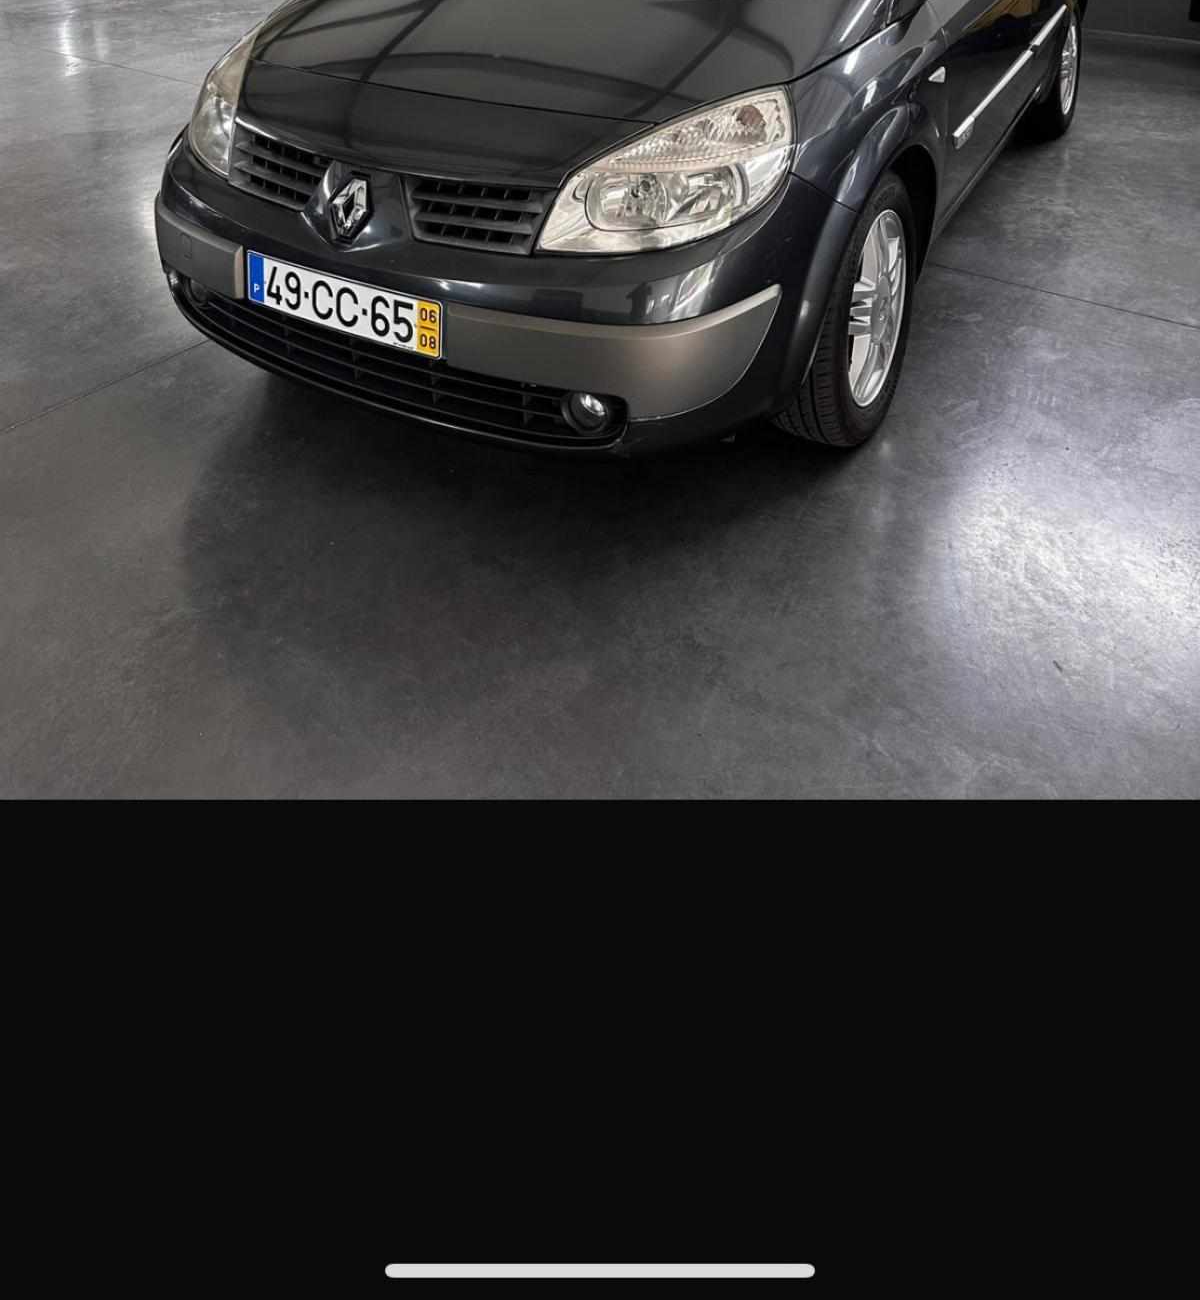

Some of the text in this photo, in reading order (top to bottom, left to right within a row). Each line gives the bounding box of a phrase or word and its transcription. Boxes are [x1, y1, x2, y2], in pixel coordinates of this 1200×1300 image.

[253, 283, 260, 293] P
[420, 307, 437, 324] 06
[420, 333, 436, 349] 08
